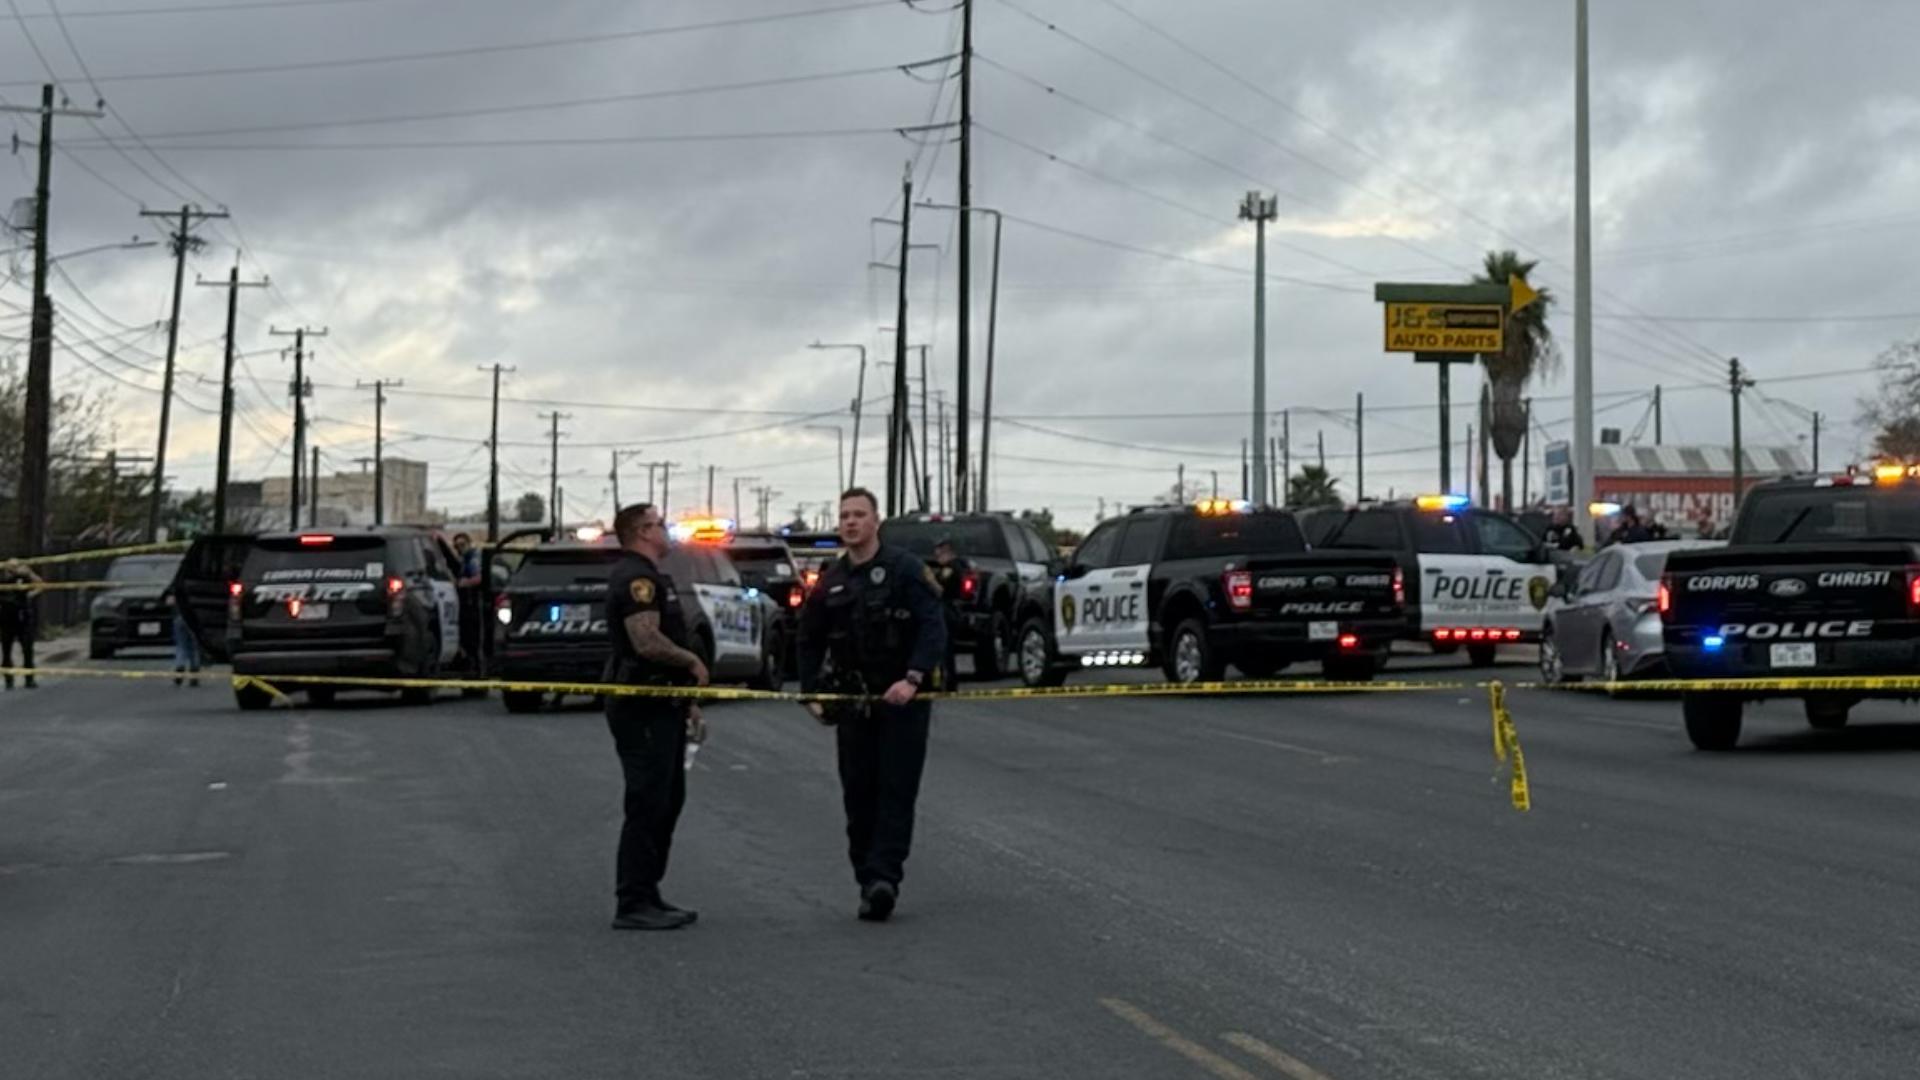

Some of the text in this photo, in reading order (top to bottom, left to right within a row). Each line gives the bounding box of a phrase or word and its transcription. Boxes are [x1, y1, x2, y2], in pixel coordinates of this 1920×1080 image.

[1391, 306, 1445, 329] J&S
[1393, 334, 1497, 348] AUTO PARTS
[262, 569, 314, 582] CORPUS
[1257, 575, 1307, 589] CORPUS
[1345, 573, 1391, 587] CHRISTI
[1687, 570, 1891, 592] CORPUS CHRISTI
[253, 584, 362, 604] POLICE
[1433, 576, 1524, 600] POLICE
[1082, 594, 1139, 624] POLICE
[1279, 600, 1366, 615] POLICE
[518, 619, 609, 637] POLIC
[1718, 620, 1875, 640] POLICE
